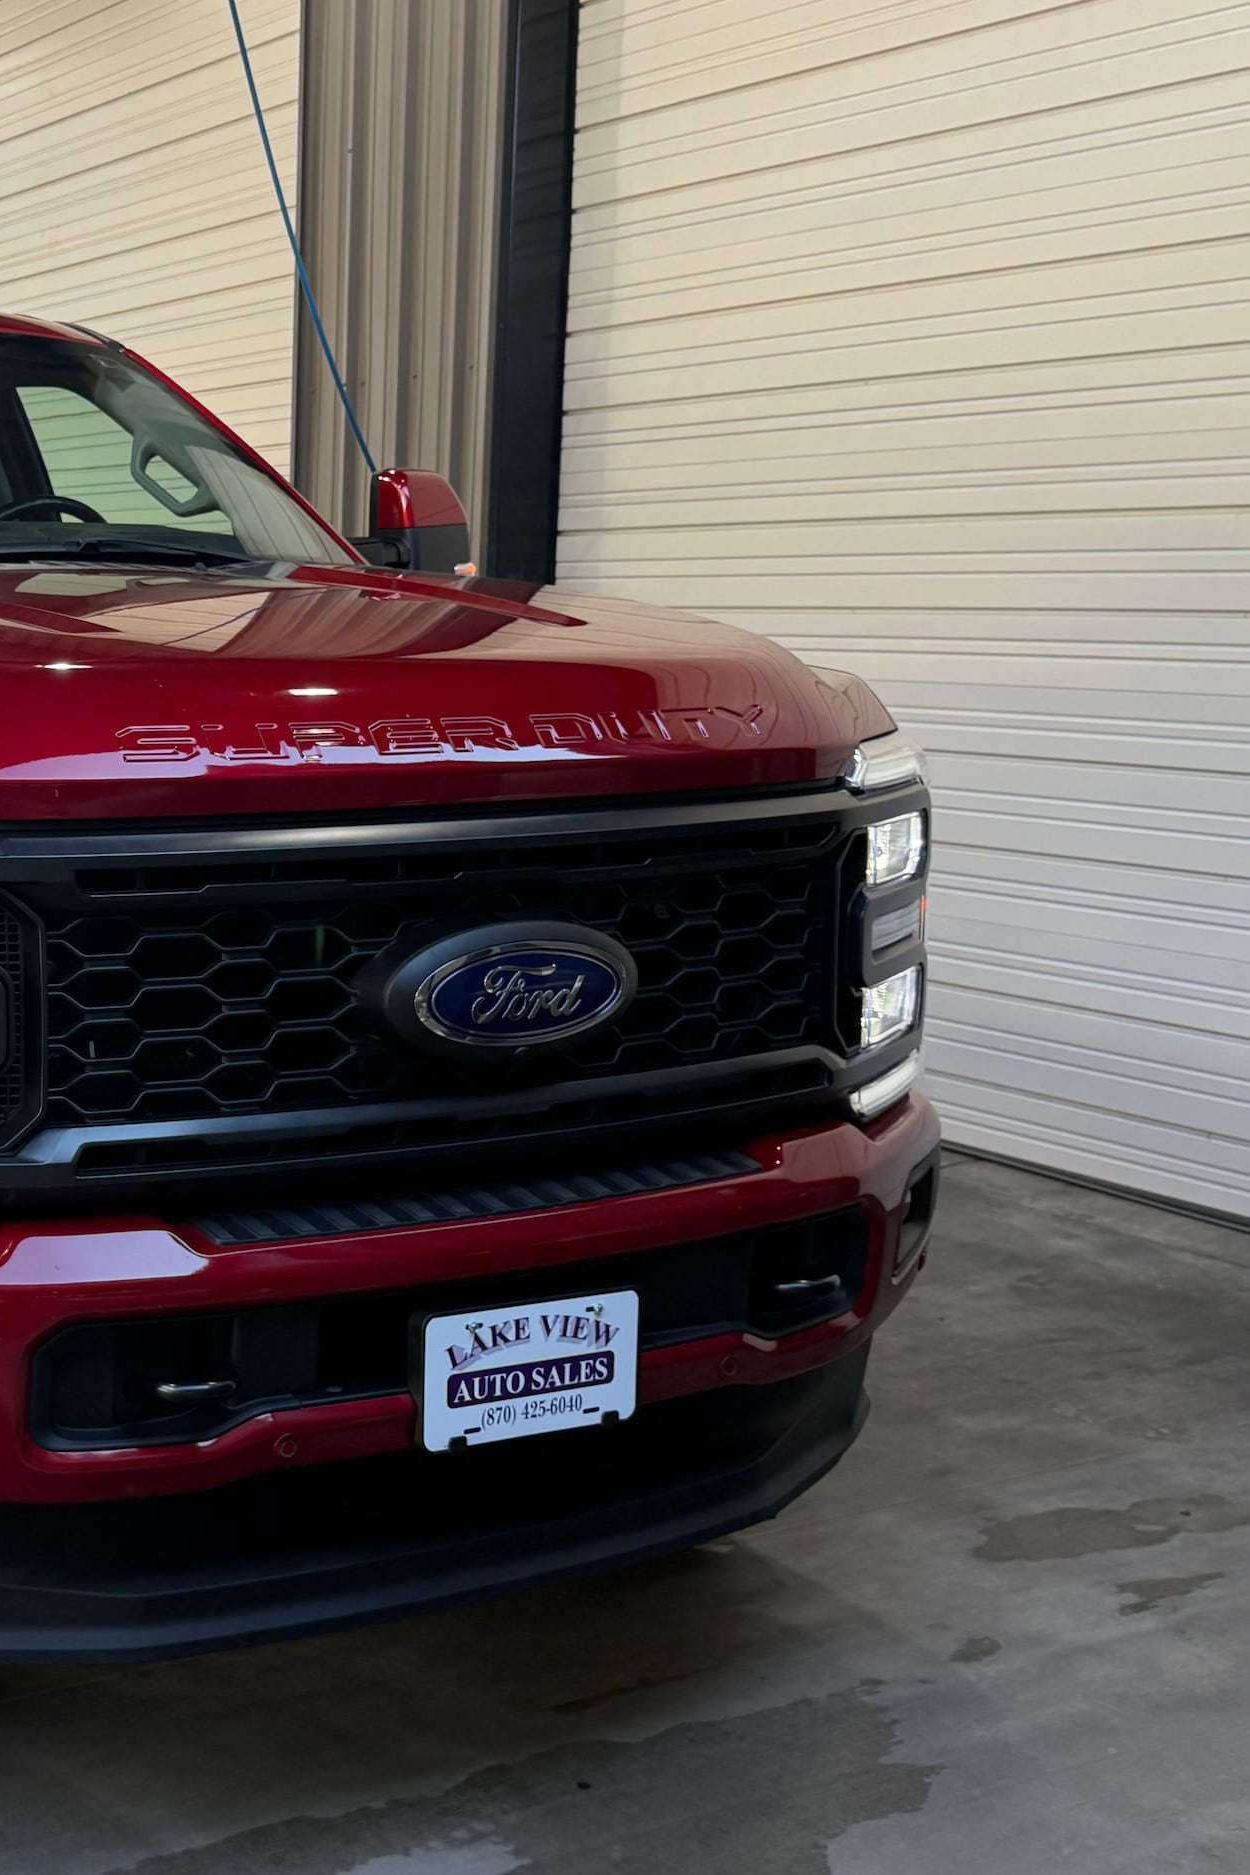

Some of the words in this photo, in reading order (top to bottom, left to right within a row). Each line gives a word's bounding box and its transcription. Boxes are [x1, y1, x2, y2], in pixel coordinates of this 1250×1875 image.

[114, 716, 521, 763] SUPER
[528, 704, 764, 750] DUTY
[471, 963, 586, 1024] Ford
[445, 1317, 531, 1371] LAKE
[540, 1314, 621, 1349] VIEW
[453, 1370, 525, 1404] AUTO
[531, 1357, 609, 1391] SALES
[481, 1405, 517, 1430] (870)
[521, 1393, 583, 1420] 425-6040
